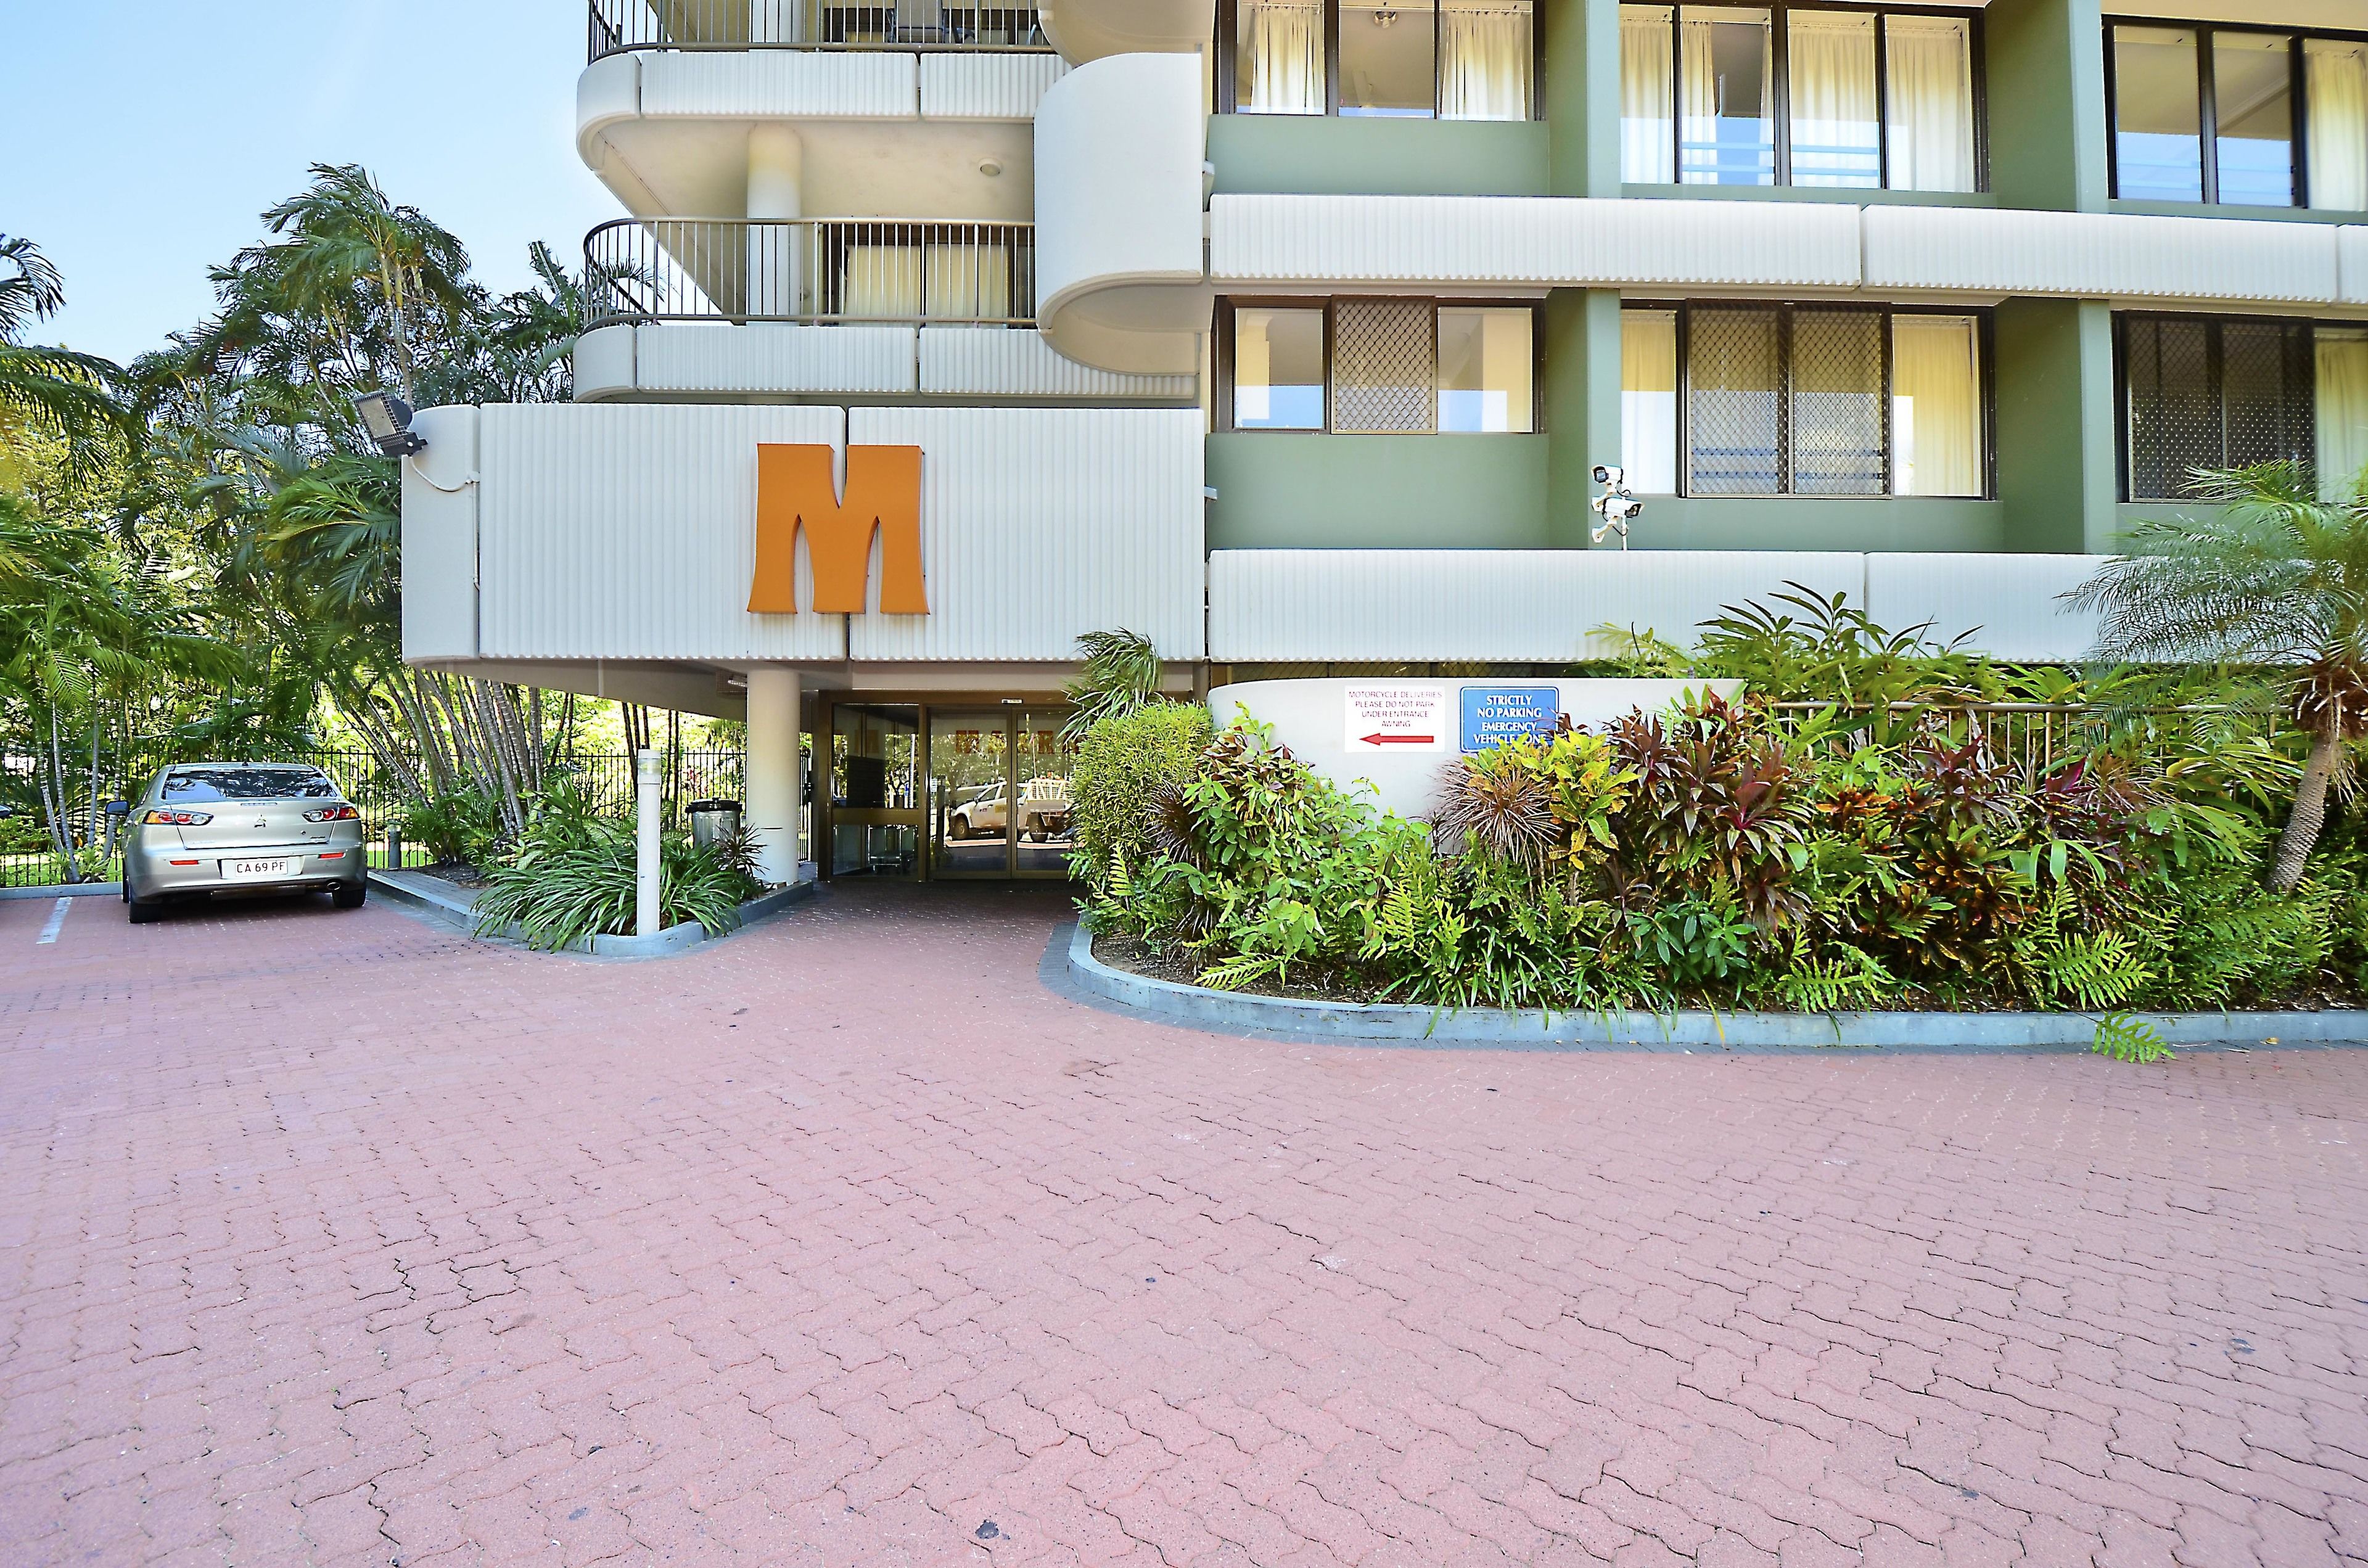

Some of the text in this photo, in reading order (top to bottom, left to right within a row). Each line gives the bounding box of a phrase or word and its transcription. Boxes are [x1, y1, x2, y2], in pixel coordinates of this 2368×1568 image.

[747, 443, 930, 615] M
[1486, 695, 1532, 705] STRICTLY
[1478, 707, 1542, 718] NO PARKING
[1481, 721, 1537, 732] EMERGENCY
[1473, 733, 1515, 744] VEHICLE
[237, 862, 286, 873] CA 69 PF
